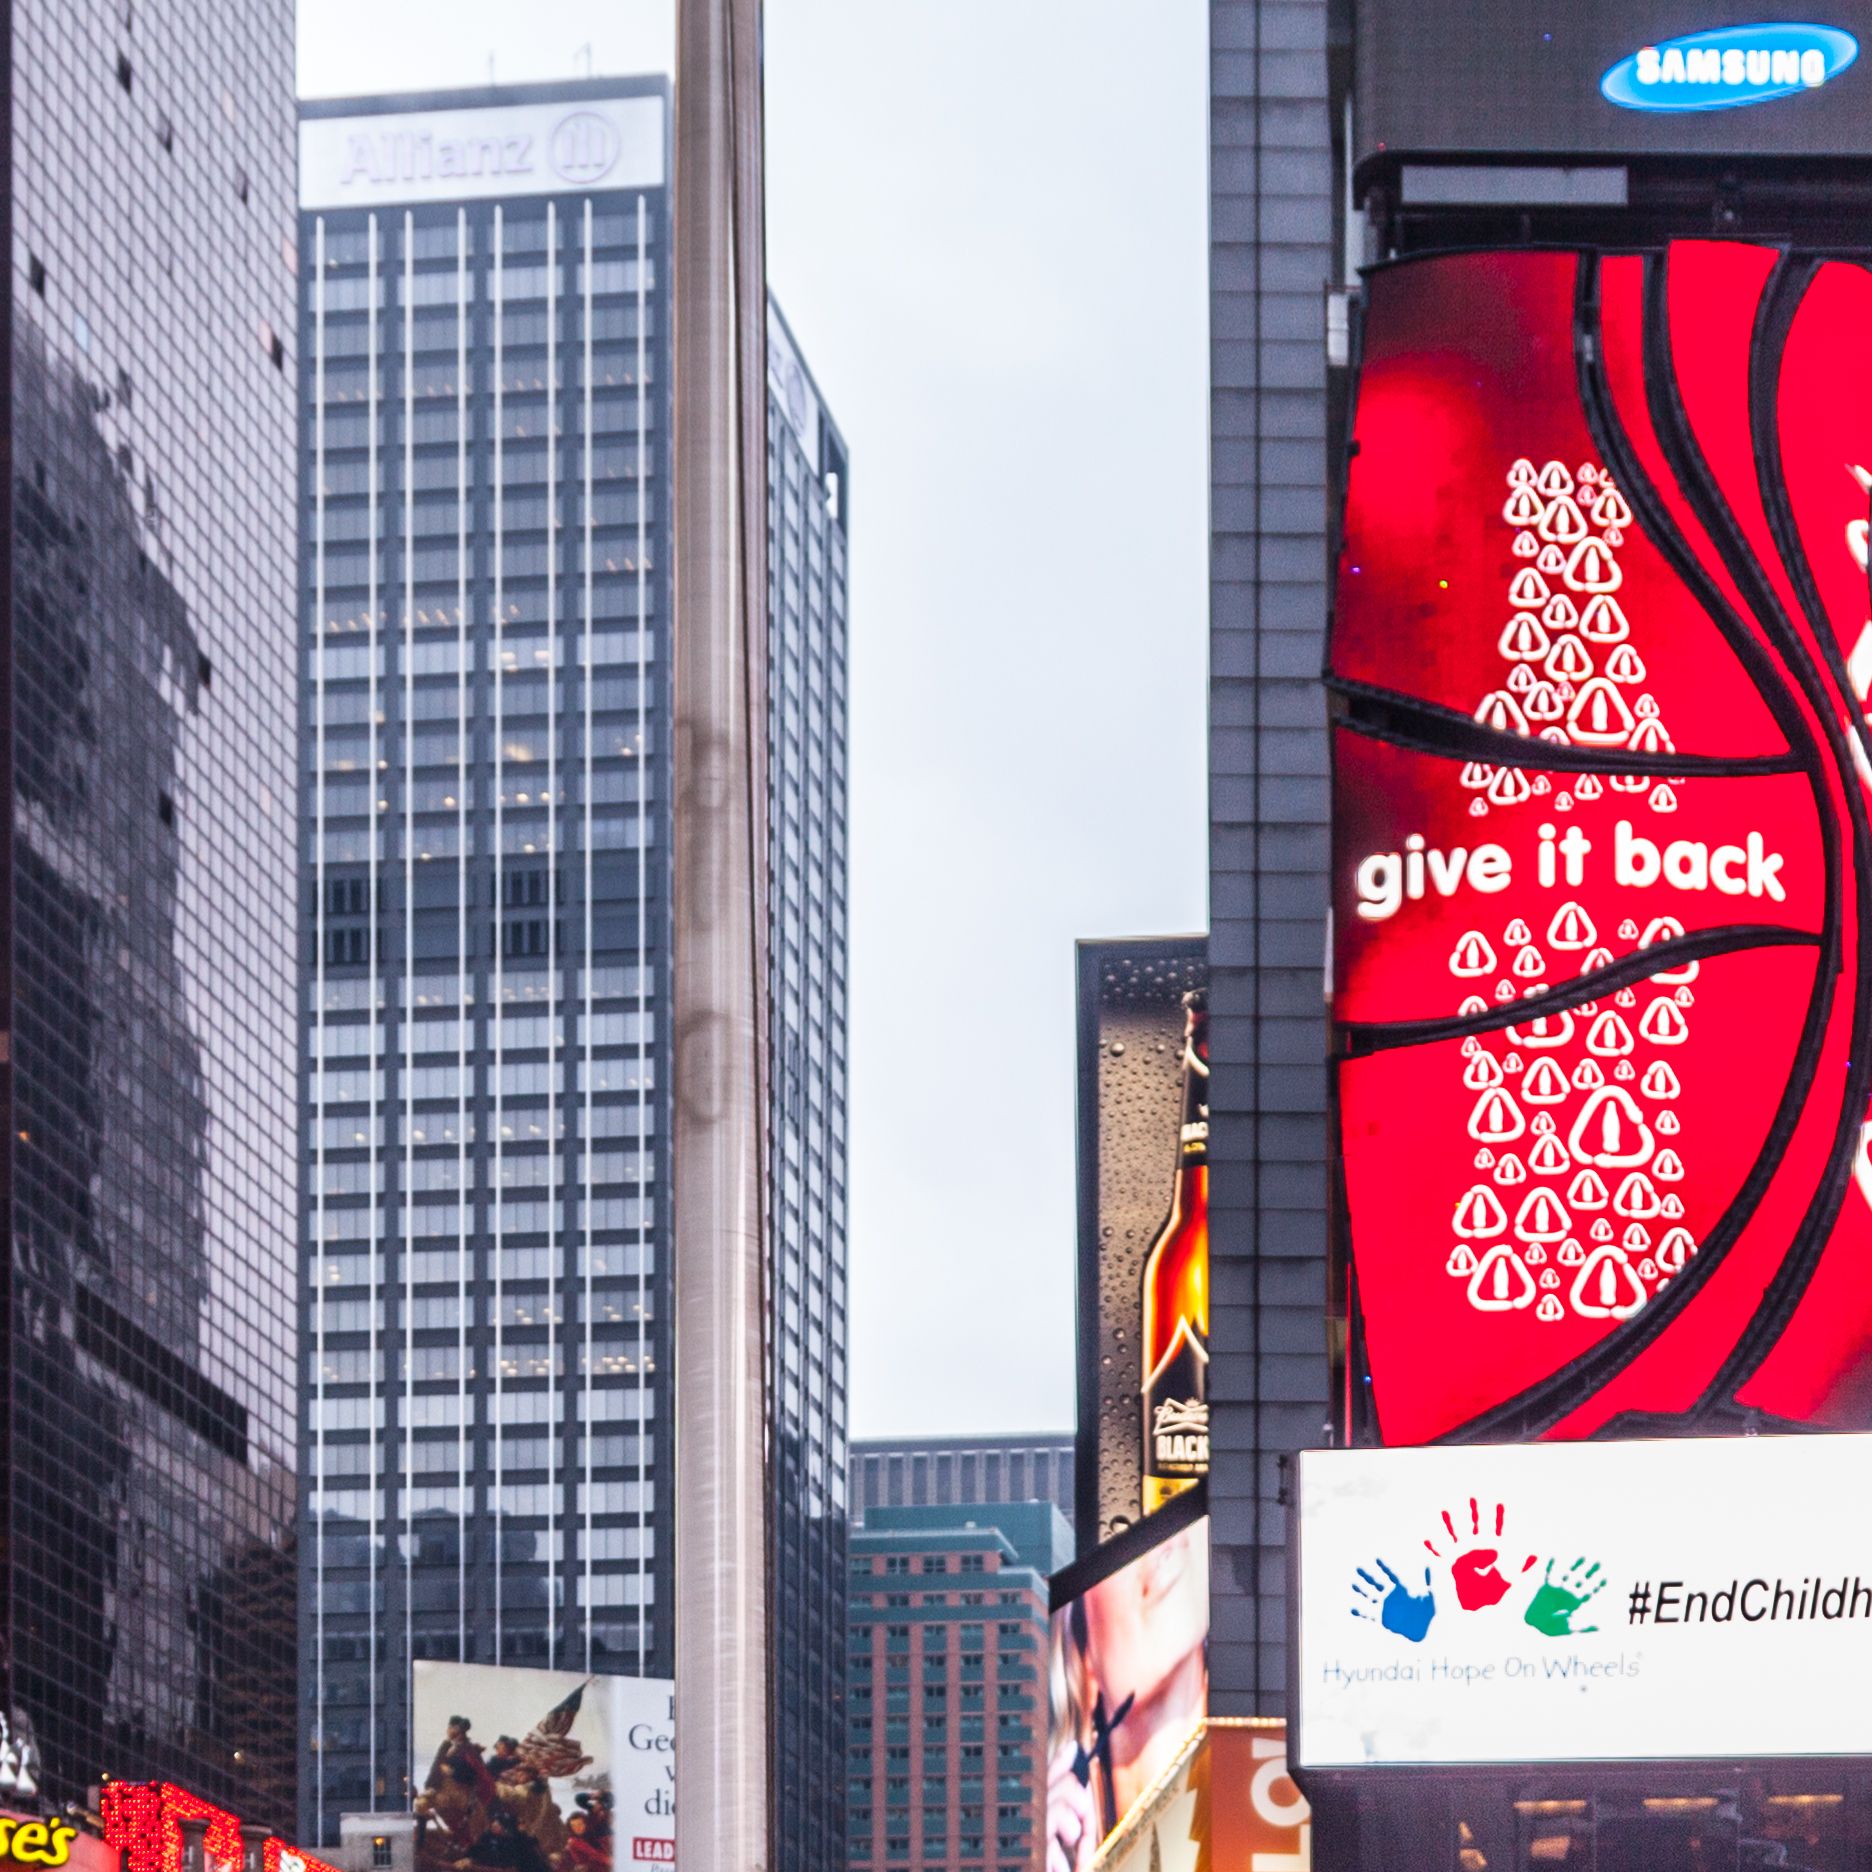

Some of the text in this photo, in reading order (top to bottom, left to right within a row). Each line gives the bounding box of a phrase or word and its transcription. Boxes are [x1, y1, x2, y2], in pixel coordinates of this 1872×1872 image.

[1635, 46, 1827, 87] SAMSUNG
[340, 131, 535, 186] Allianz
[1356, 819, 1788, 921] give it back
[1321, 1651, 1642, 1689] Hyundai Hope On Wheels
[635, 1839, 674, 1861] LEAD
